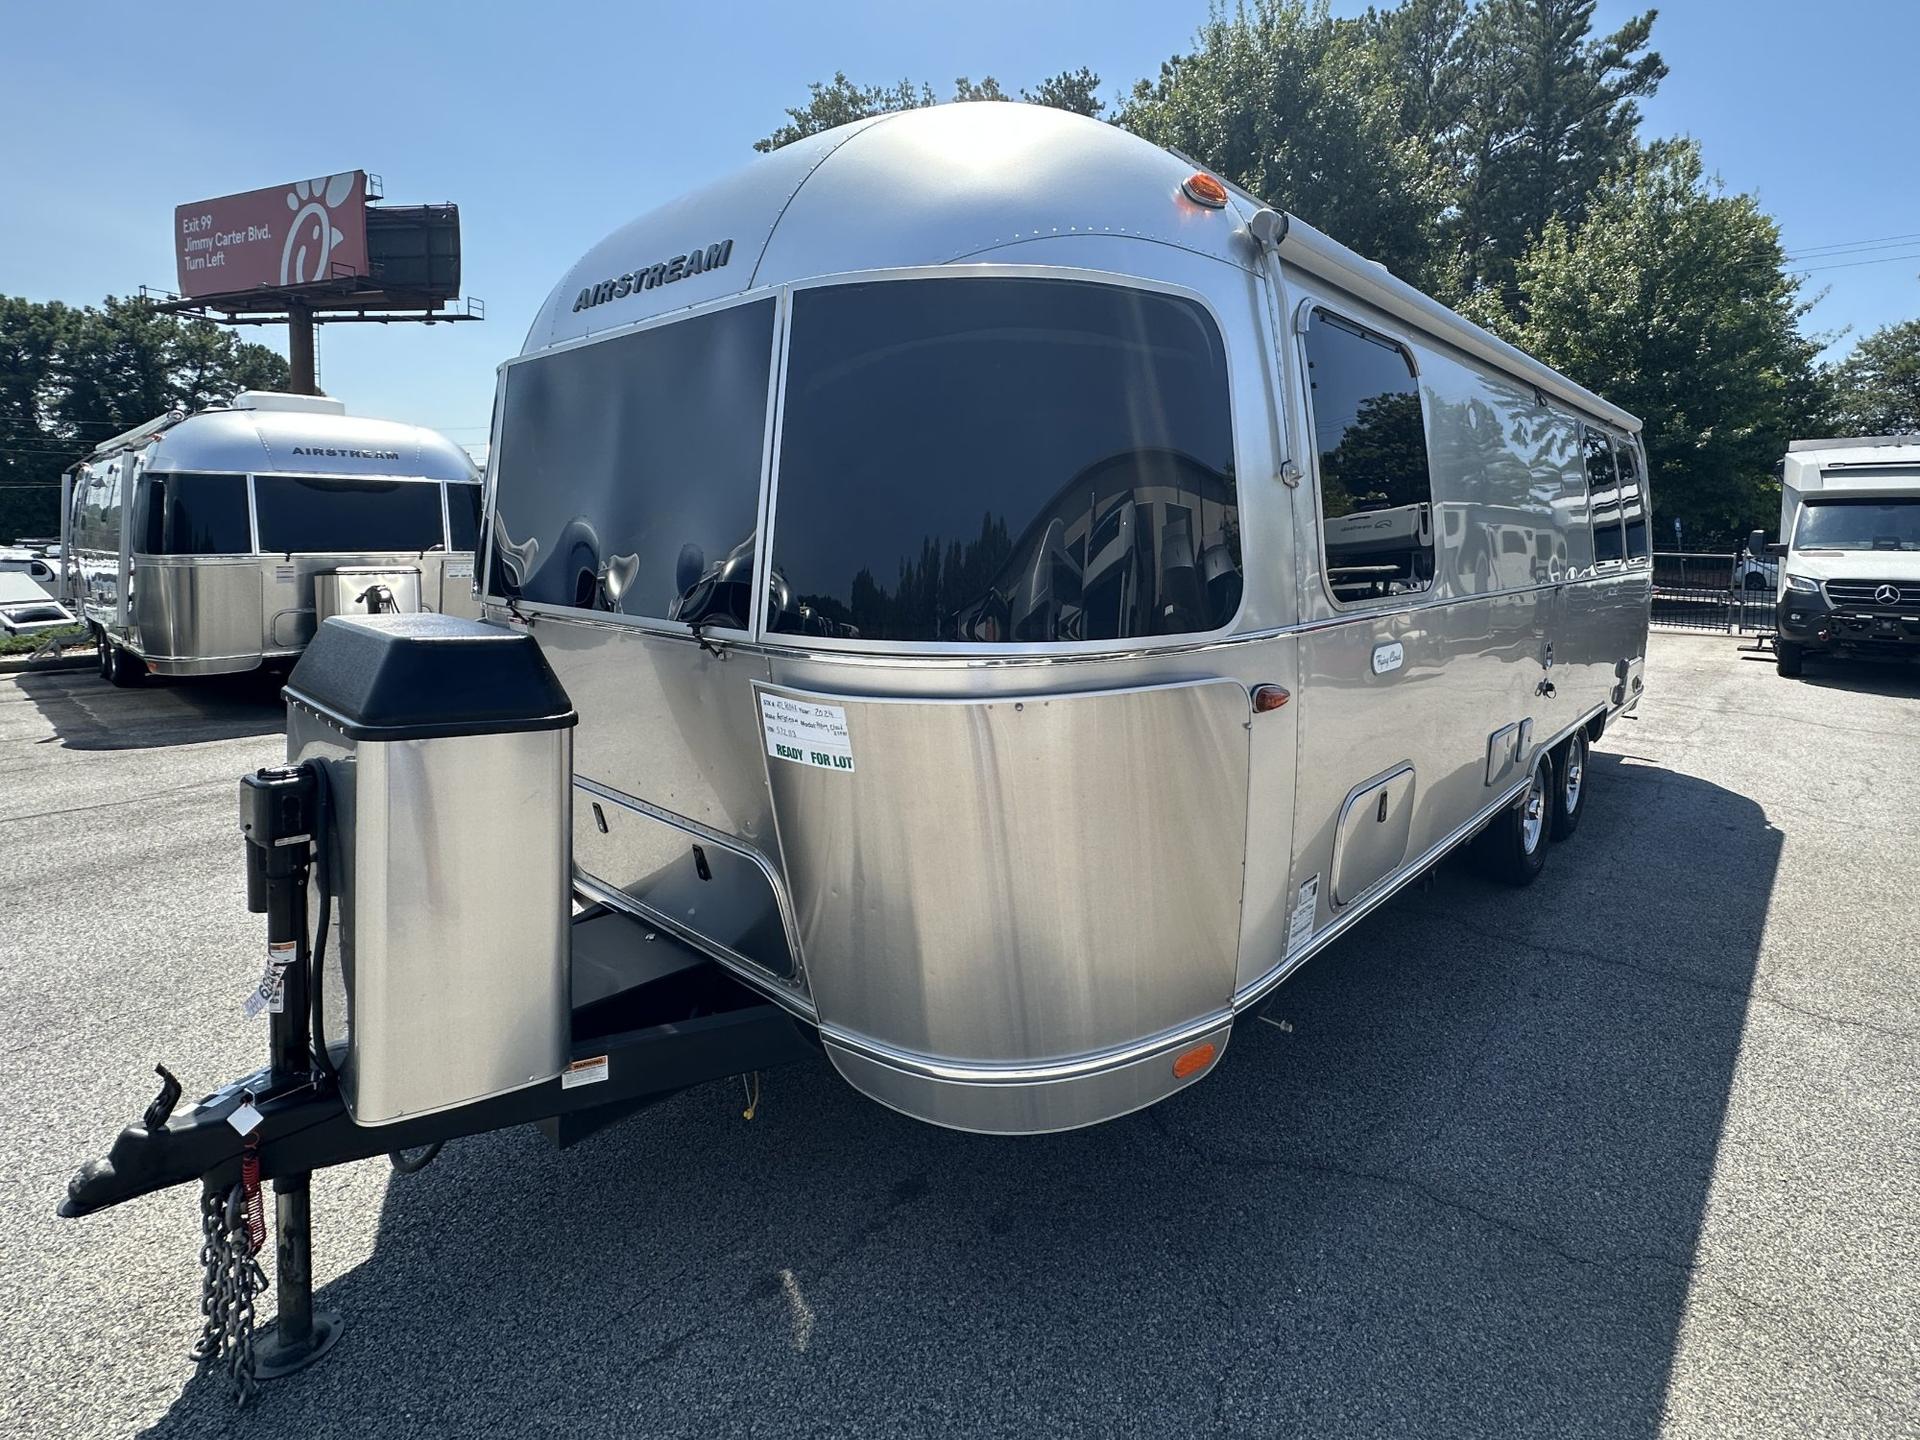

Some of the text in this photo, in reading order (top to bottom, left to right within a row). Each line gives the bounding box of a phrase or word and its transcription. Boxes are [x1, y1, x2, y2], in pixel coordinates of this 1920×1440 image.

[183, 214, 212, 233] Exit 99
[184, 224, 271, 253] Jimmy Carter Blvd.
[185, 251, 225, 271] Turn Left
[572, 239, 733, 313] AIRSTREAM
[292, 447, 399, 460] AIRSTREAM
[815, 708, 834, 718] 2024
[776, 744, 852, 768] READY FOR LOT
